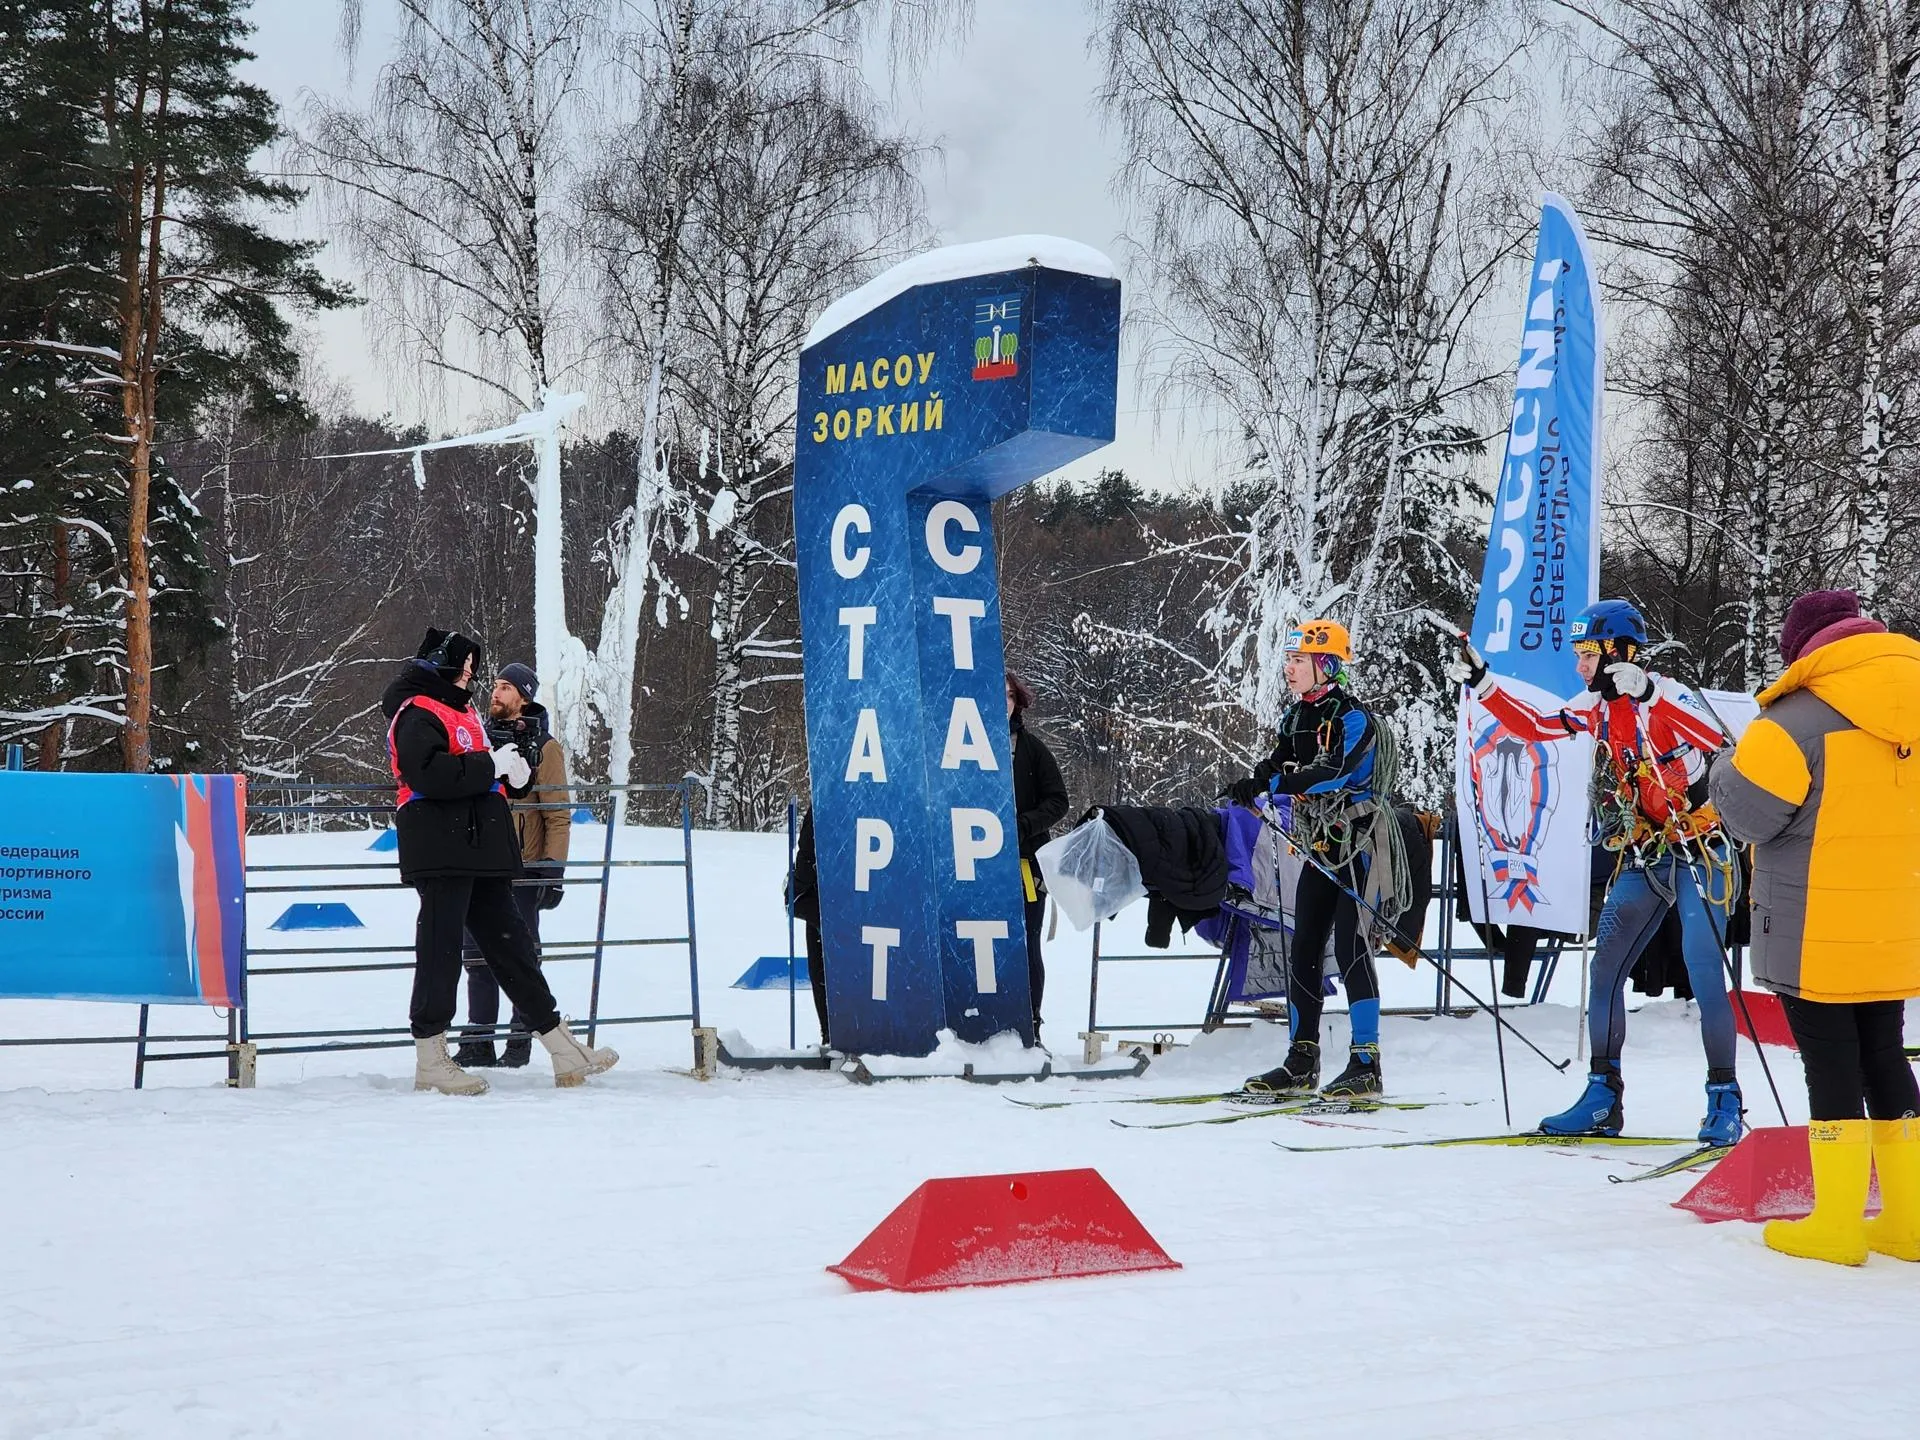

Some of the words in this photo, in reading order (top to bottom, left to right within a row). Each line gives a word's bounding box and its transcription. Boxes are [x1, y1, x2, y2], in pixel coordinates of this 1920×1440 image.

[825, 352, 936, 395] МАСОУ
[812, 390, 944, 444] ЗОРКИЙ
[1571, 623, 1584, 634] 39
[830, 503, 900, 1001] СТАРТ
[925, 500, 1009, 994] СТАРТ
[0, 888, 51, 901] ризма
[1301, 1104, 1350, 1115] FISCHER
[1525, 1137, 1583, 1145] FISCHER
